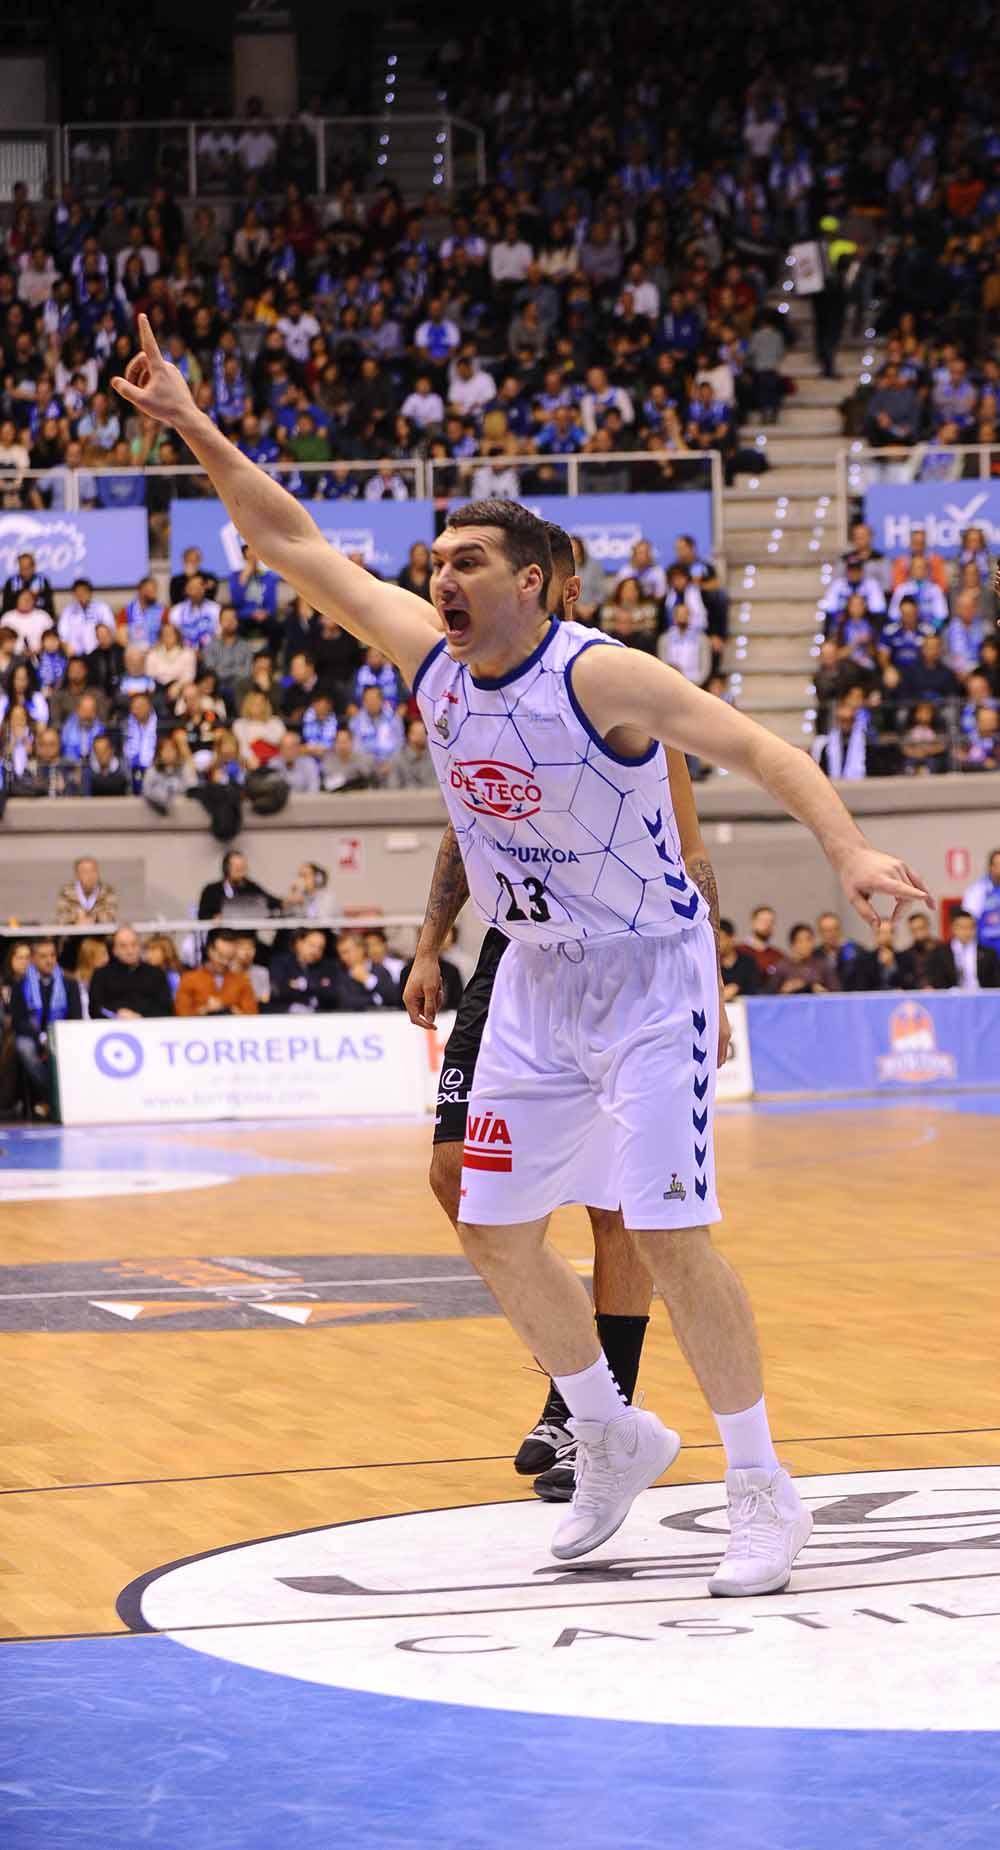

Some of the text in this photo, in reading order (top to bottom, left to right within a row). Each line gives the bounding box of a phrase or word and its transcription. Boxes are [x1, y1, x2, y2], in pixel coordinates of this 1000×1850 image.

[450, 770, 542, 802] DETECO
[496, 871, 551, 922] 23
[160, 1034, 385, 1066] TORREPLAS
